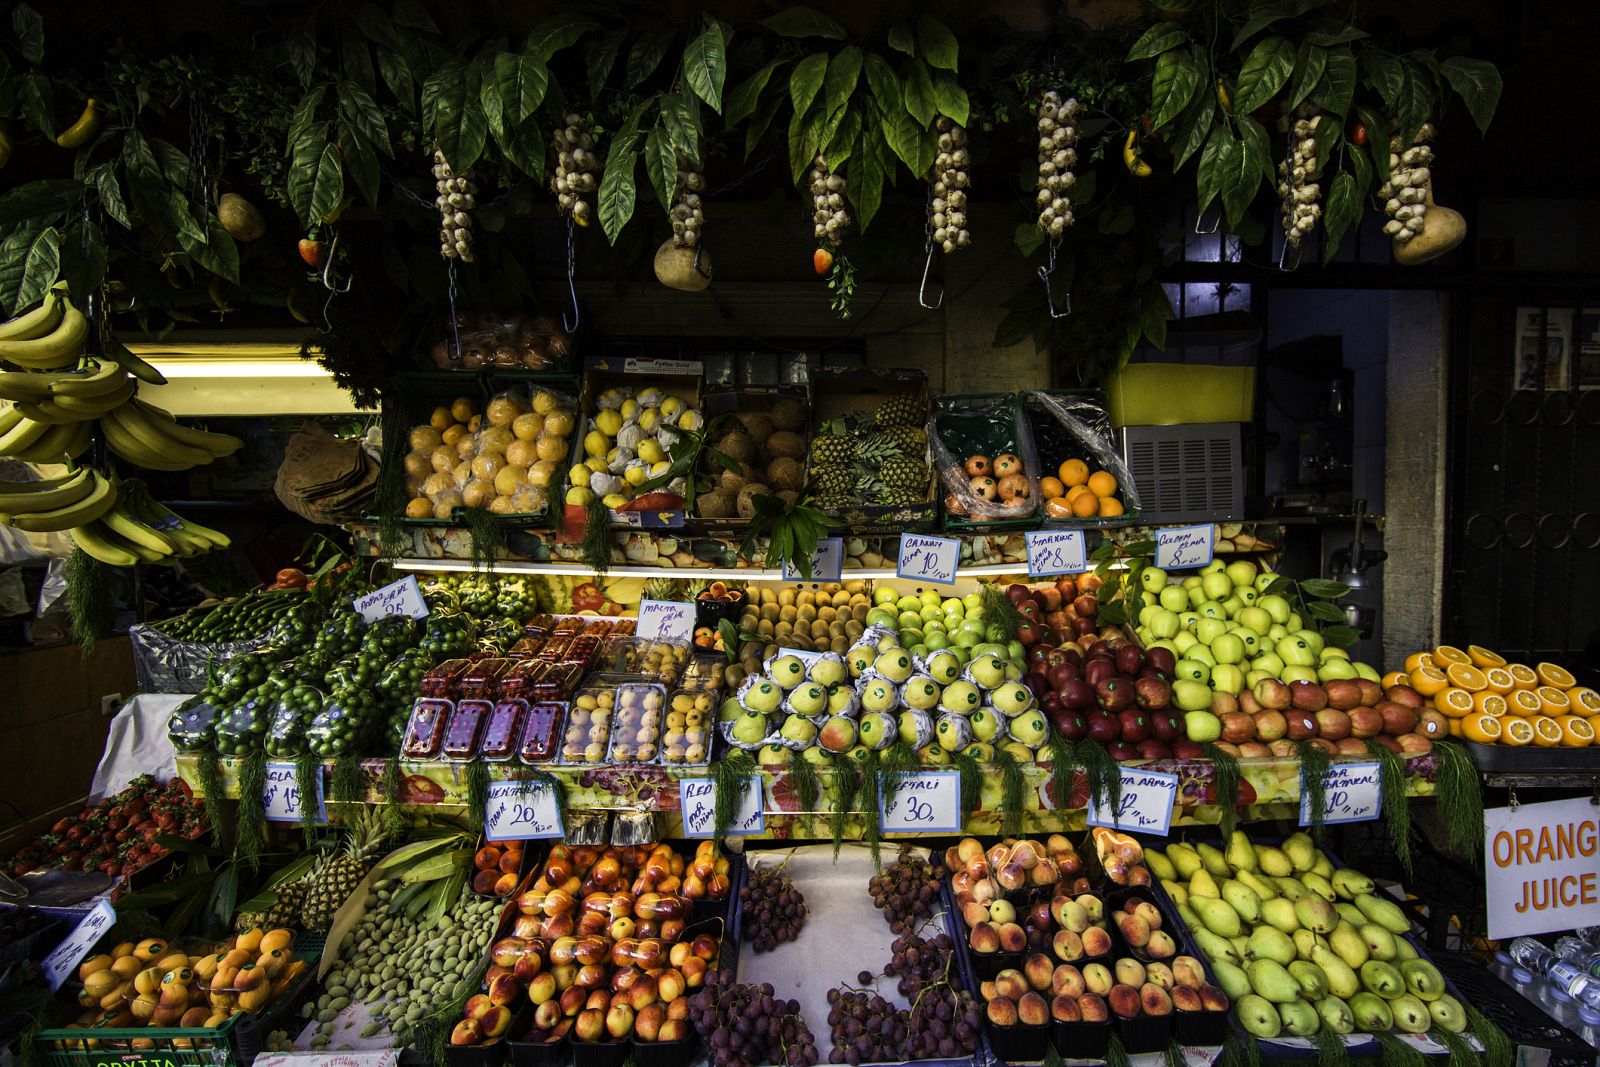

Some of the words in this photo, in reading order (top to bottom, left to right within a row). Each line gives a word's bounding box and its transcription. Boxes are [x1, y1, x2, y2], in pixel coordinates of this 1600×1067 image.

[918, 552, 938, 574] 10
[1052, 547, 1064, 568] 8
[1168, 549, 1183, 567] 8
[686, 783, 713, 799] RED
[904, 796, 932, 822] 30
[1323, 791, 1348, 814] 10
[510, 804, 535, 826] 20
[1493, 820, 1600, 868] ORANG
[1515, 873, 1598, 913] JUICE
